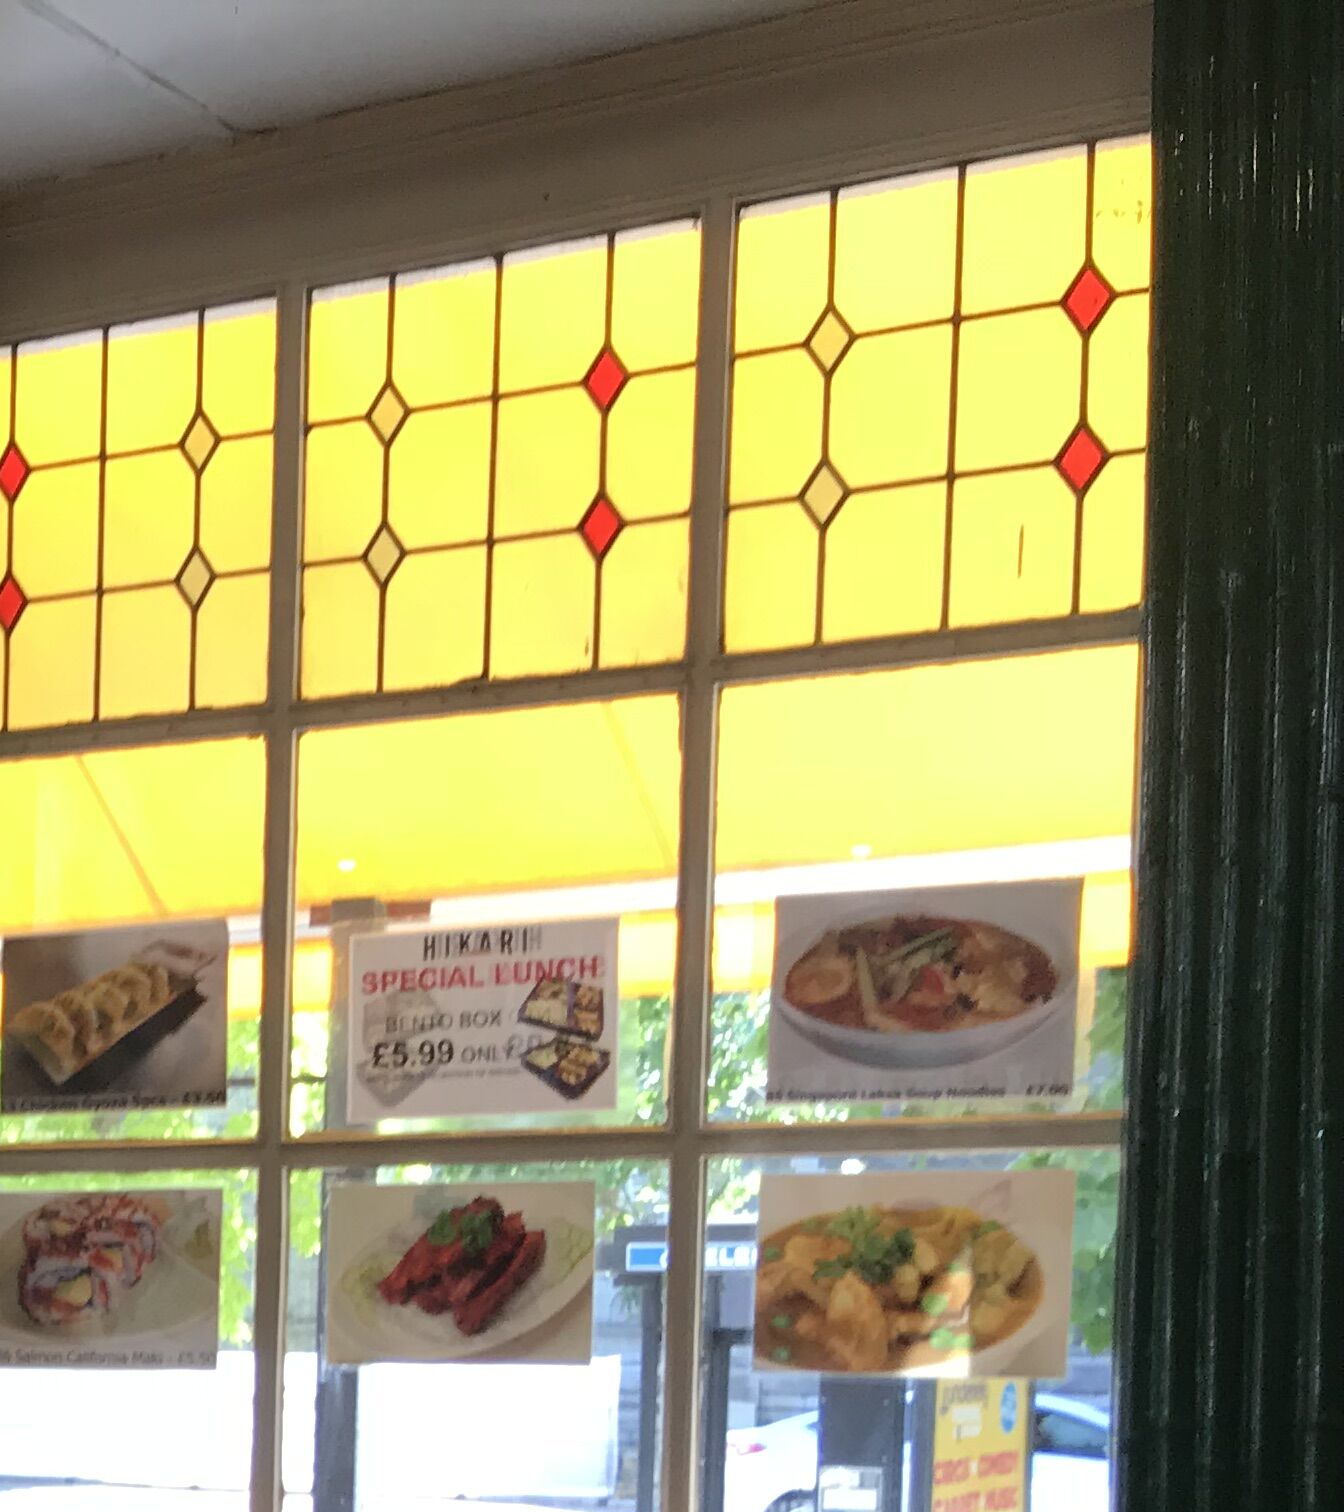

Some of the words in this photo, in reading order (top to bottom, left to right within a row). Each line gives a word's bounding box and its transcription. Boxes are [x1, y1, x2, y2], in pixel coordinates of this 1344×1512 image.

[423, 927, 529, 961] HIKARI
[362, 964, 484, 996] SPECIAL
[494, 955, 599, 987] LUNCH
[385, 1012, 452, 1034] BENTO
[459, 1009, 503, 1029] BOX
[372, 1039, 455, 1069] £5.99
[461, 1042, 515, 1064] ONLY
